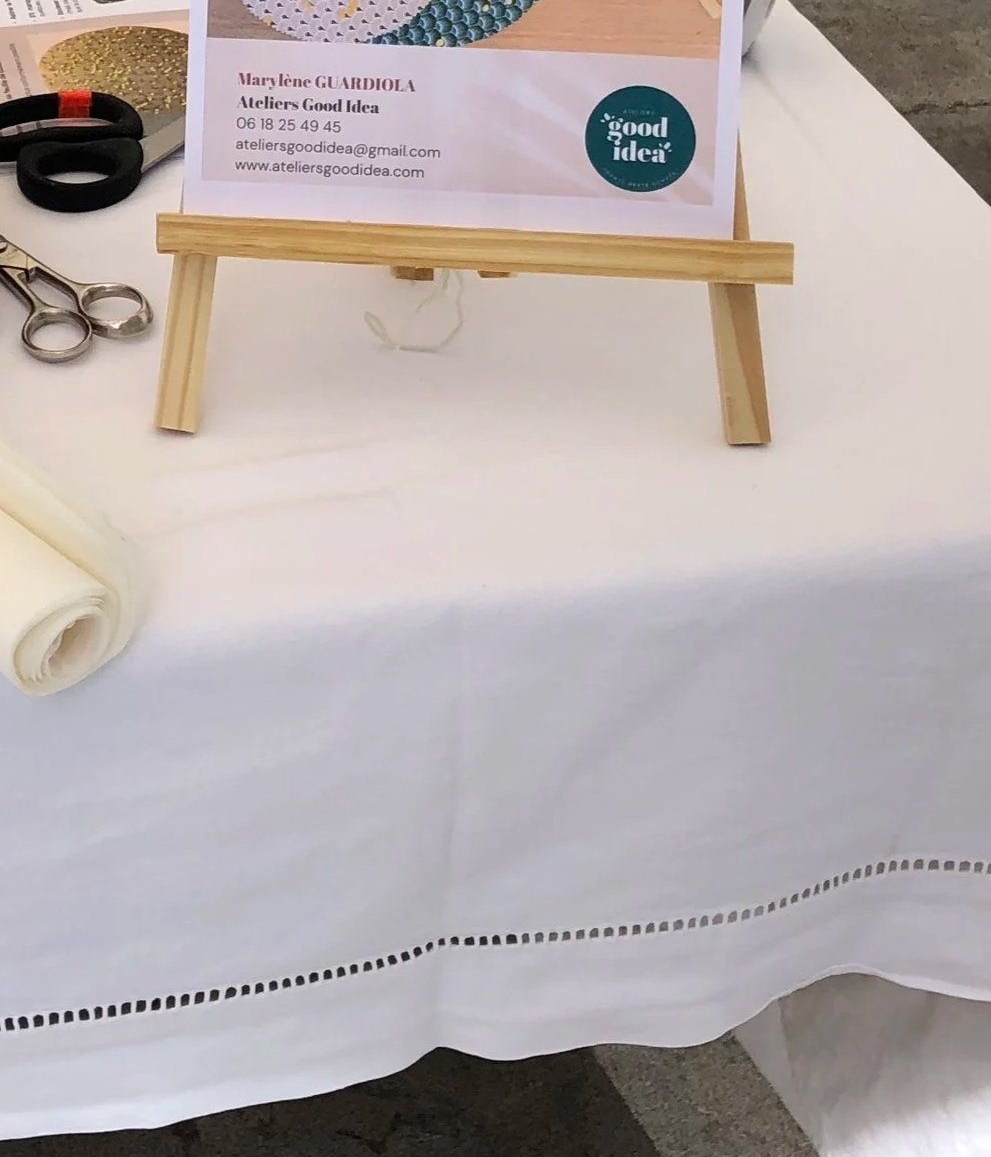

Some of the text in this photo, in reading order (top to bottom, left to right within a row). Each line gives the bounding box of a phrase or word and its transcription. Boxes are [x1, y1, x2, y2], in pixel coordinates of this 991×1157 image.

[237, 72, 416, 93] Marylène GUARDIOLA
[237, 95, 380, 114] Ateliers Good Idea
[236, 116, 342, 134] 06 18 25 49 45
[606, 116, 668, 146] good
[235, 138, 442, 159] ateliersgoodidea@gmail.com
[612, 140, 667, 164] idea
[234, 159, 425, 179] www.ateliersgoodidea.com
